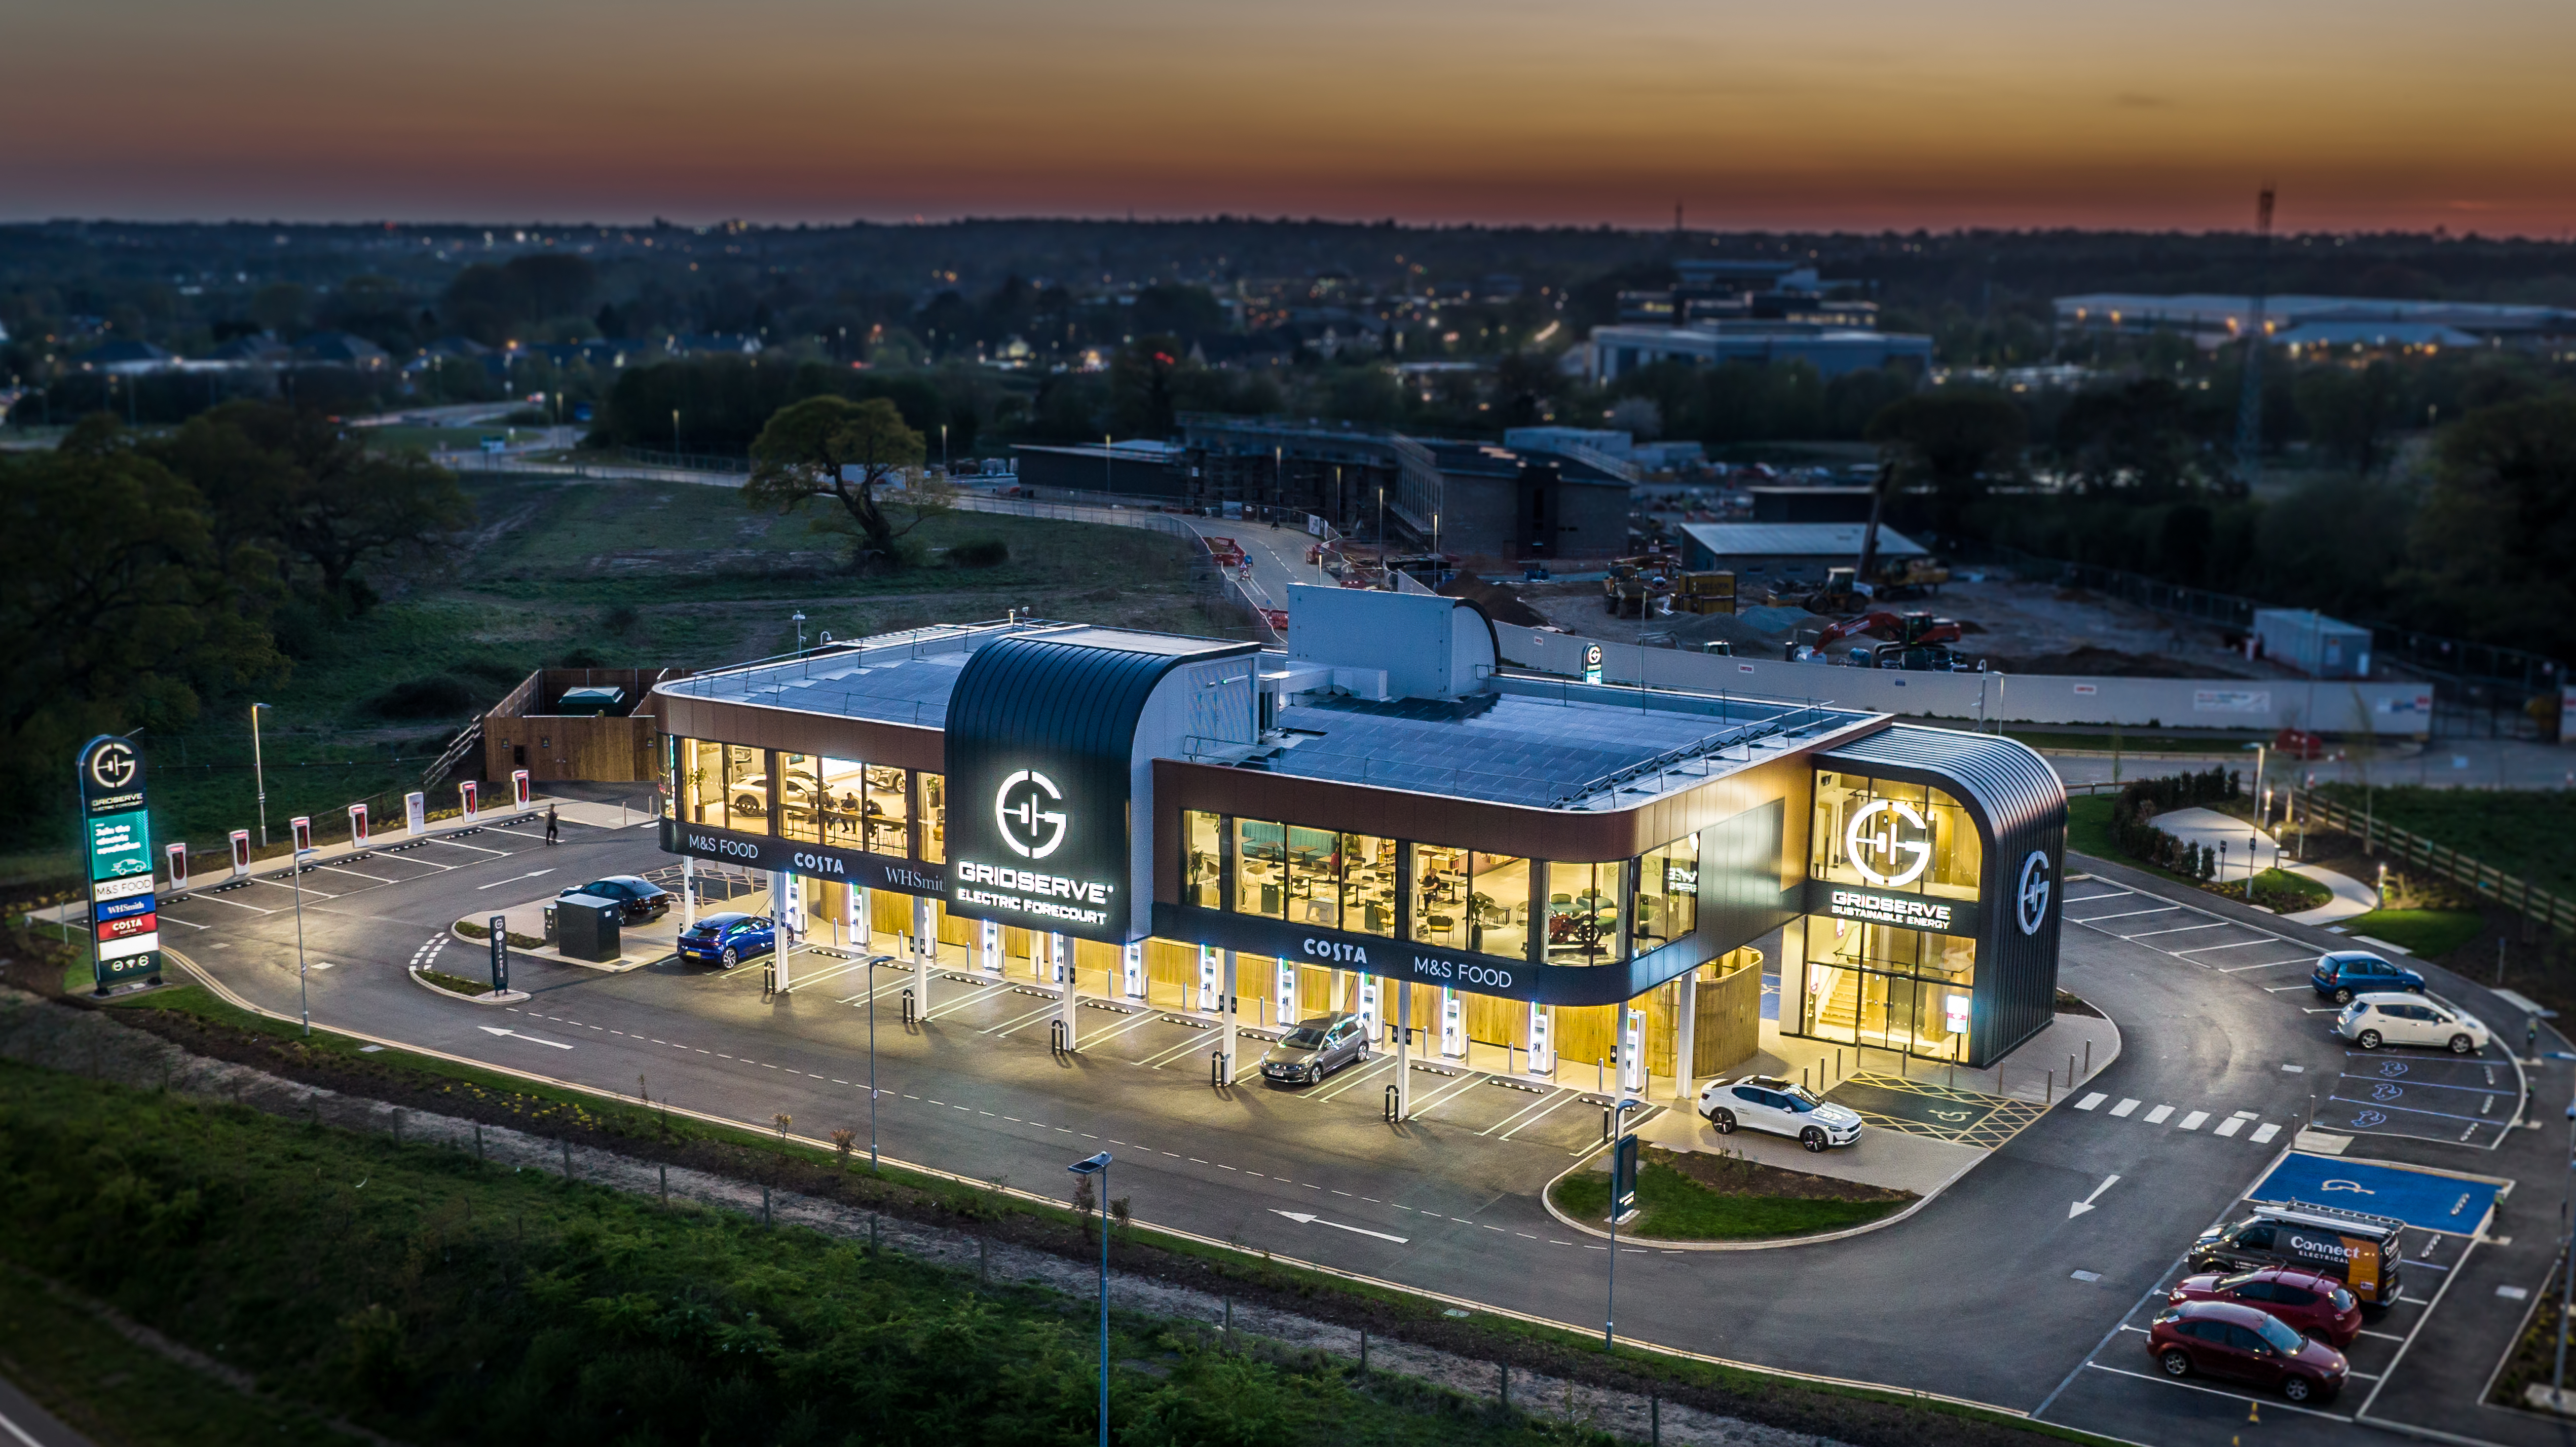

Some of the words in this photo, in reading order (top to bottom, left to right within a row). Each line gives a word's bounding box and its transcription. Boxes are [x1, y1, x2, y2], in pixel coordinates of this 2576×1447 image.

[689, 834, 716, 852] M&S
[720, 839, 759, 859] FOOD
[794, 852, 845, 874] COSTA
[97, 885, 119, 896] M&S
[122, 880, 151, 892] FOOD
[107, 901, 145, 914] WHSmith
[957, 887, 1021, 911] ELECTRIC
[1024, 899, 1107, 925] FORECOURT
[1831, 904, 1904, 923] SUSTAINABLE
[1906, 915, 1950, 930] ENERGY
[1832, 890, 1951, 920] GRIDSERVE
[112, 918, 143, 931] COSTA
[1303, 938, 1367, 964] COSTA
[1414, 956, 1452, 978] M&S
[1459, 964, 1512, 988] FOOD
[2291, 1236, 2360, 1259] Connect
[2298, 1250, 2349, 1264] ELECTRICAL
